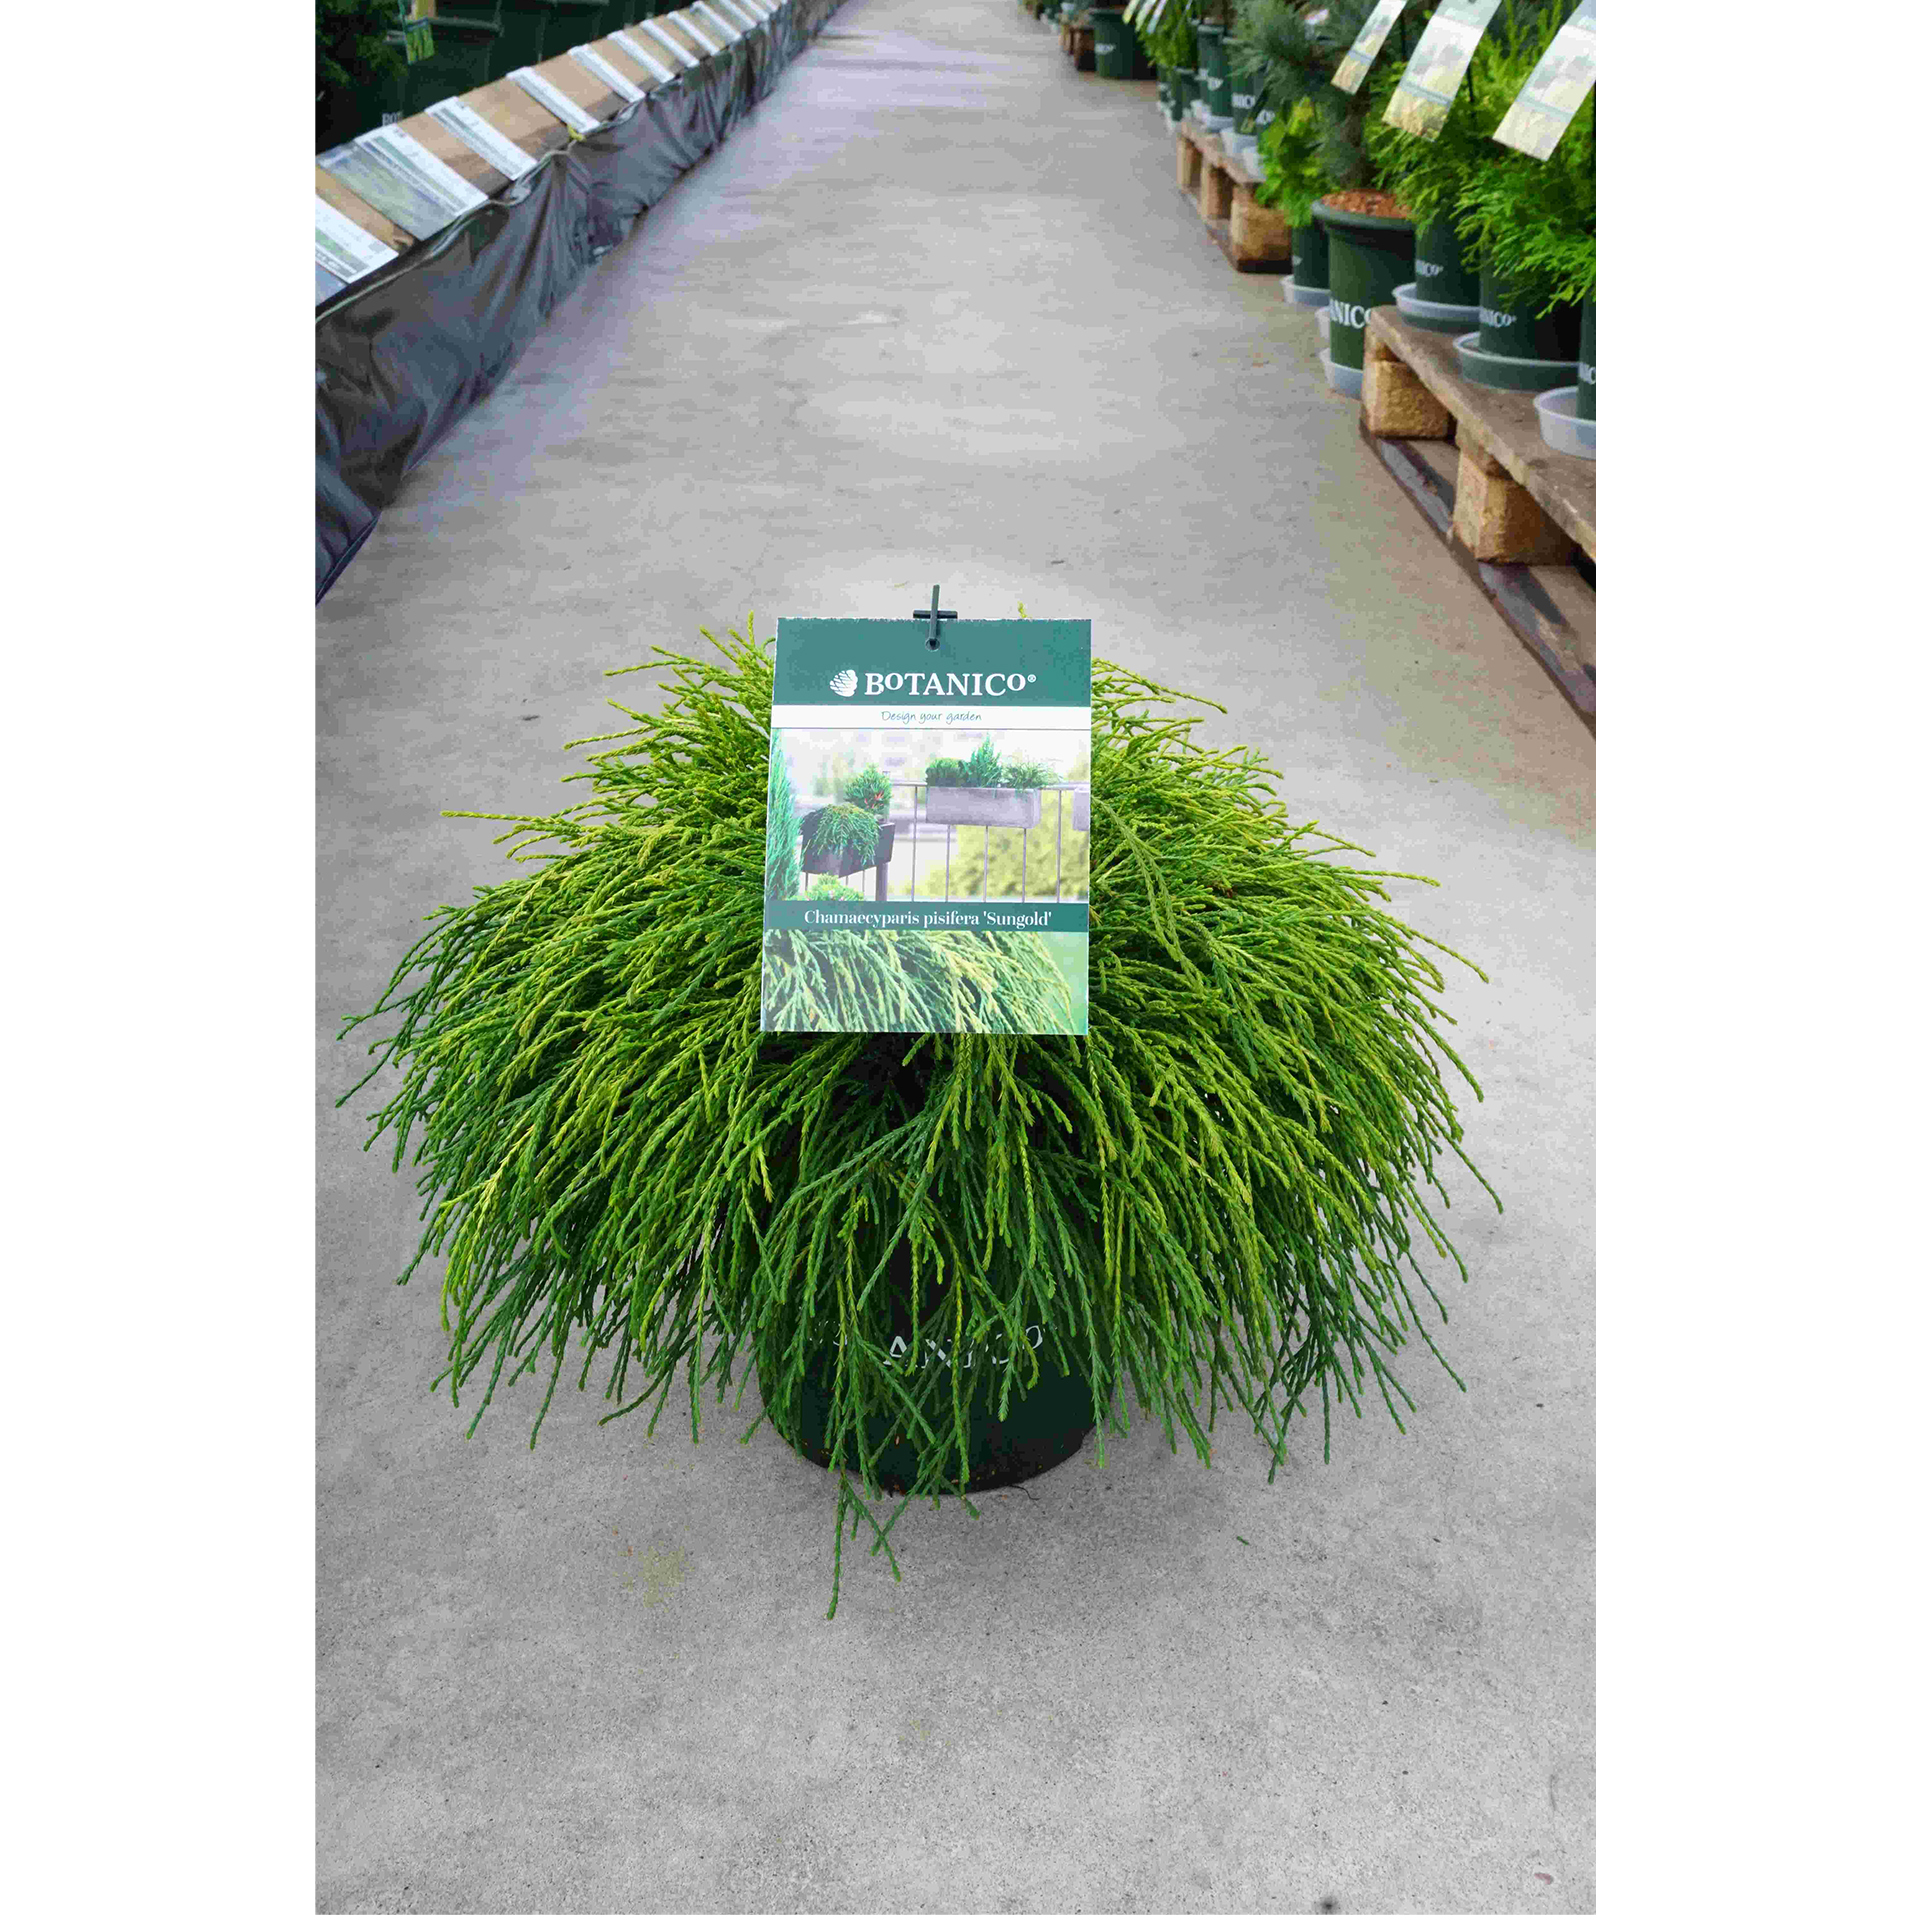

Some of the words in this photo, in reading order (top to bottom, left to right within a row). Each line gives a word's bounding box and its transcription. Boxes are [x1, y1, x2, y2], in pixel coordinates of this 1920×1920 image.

[880, 710, 917, 725] Design
[920, 712, 943, 725] your
[945, 710, 982, 725] garden
[803, 909, 920, 928] Chamaecyparis
[923, 910, 980, 929] pisifera
[983, 911, 1053, 930] 'Sungold'
